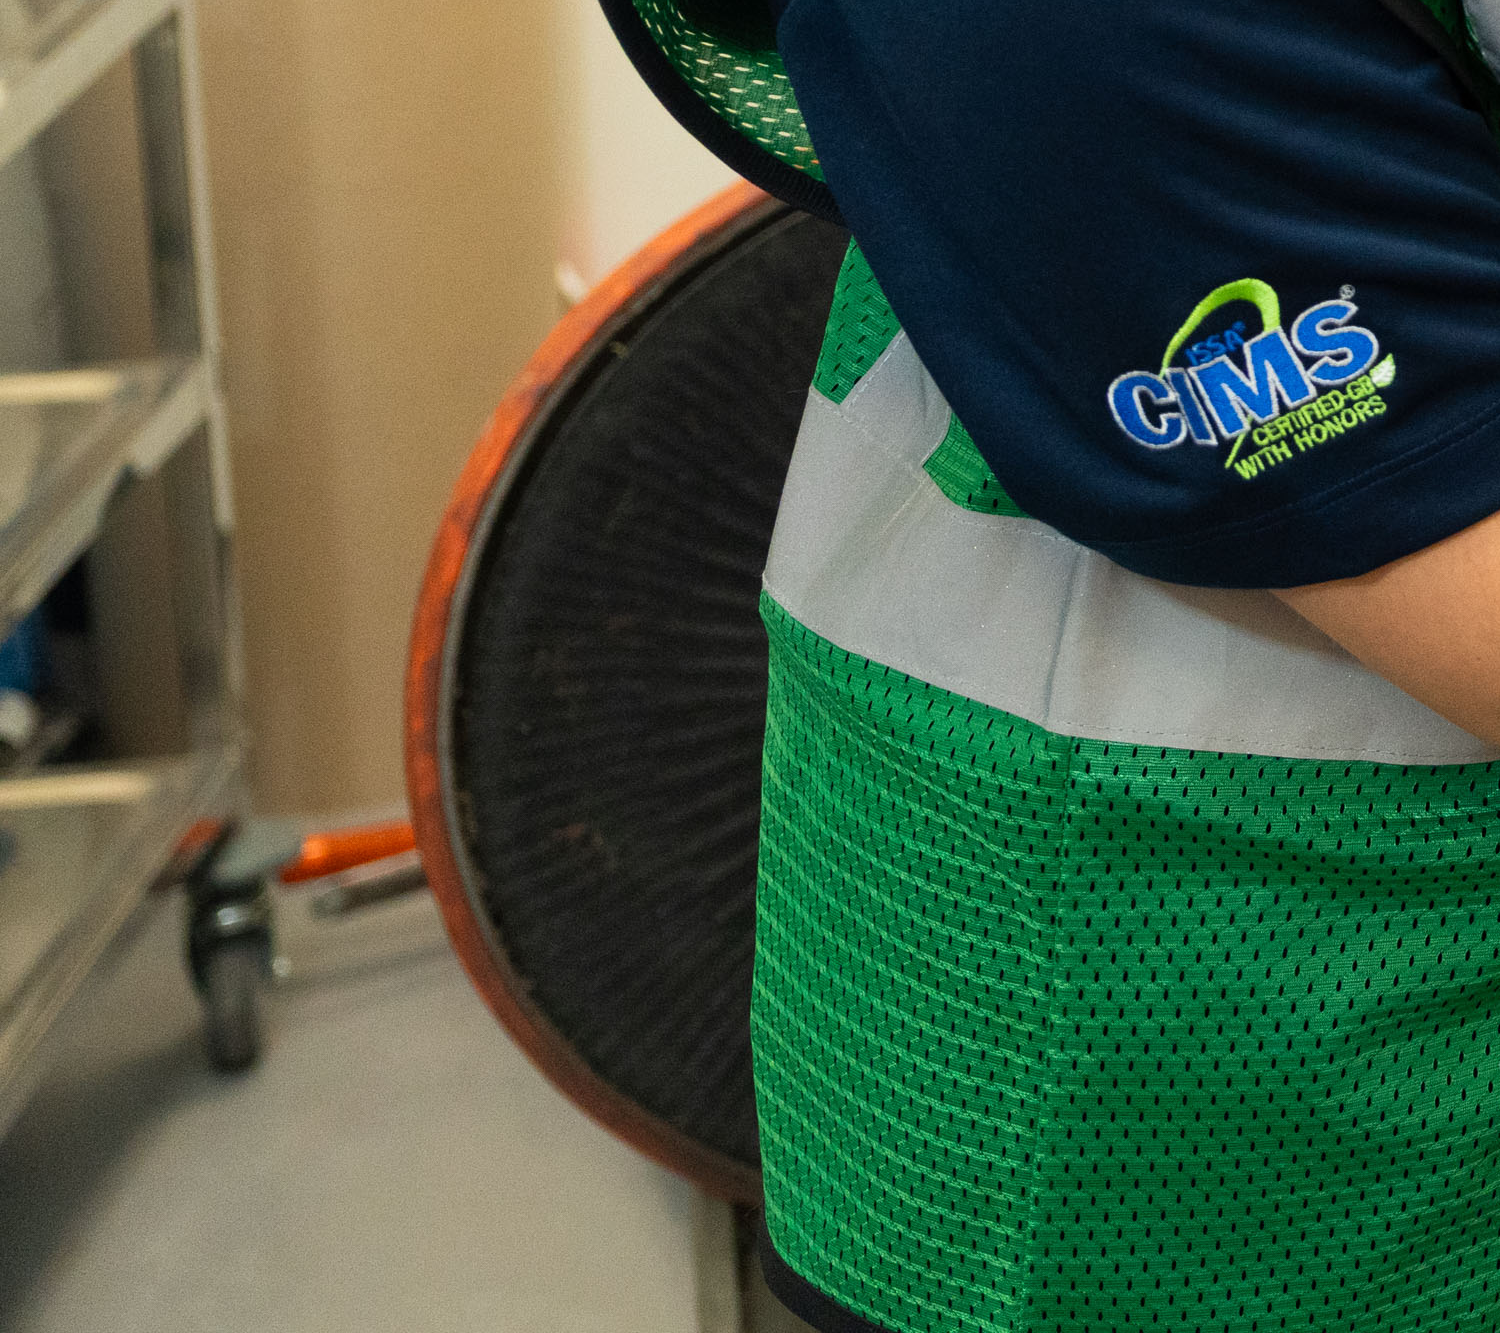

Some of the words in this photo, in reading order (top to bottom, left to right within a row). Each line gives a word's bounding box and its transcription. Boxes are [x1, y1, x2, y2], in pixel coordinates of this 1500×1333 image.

[1107, 298, 1380, 449] CIMS
[1185, 328, 1246, 365] ISSA
[1234, 442, 1293, 480] WITH
[1298, 395, 1388, 451] HONORS
[1252, 375, 1376, 447] CERTIFIED-GB
